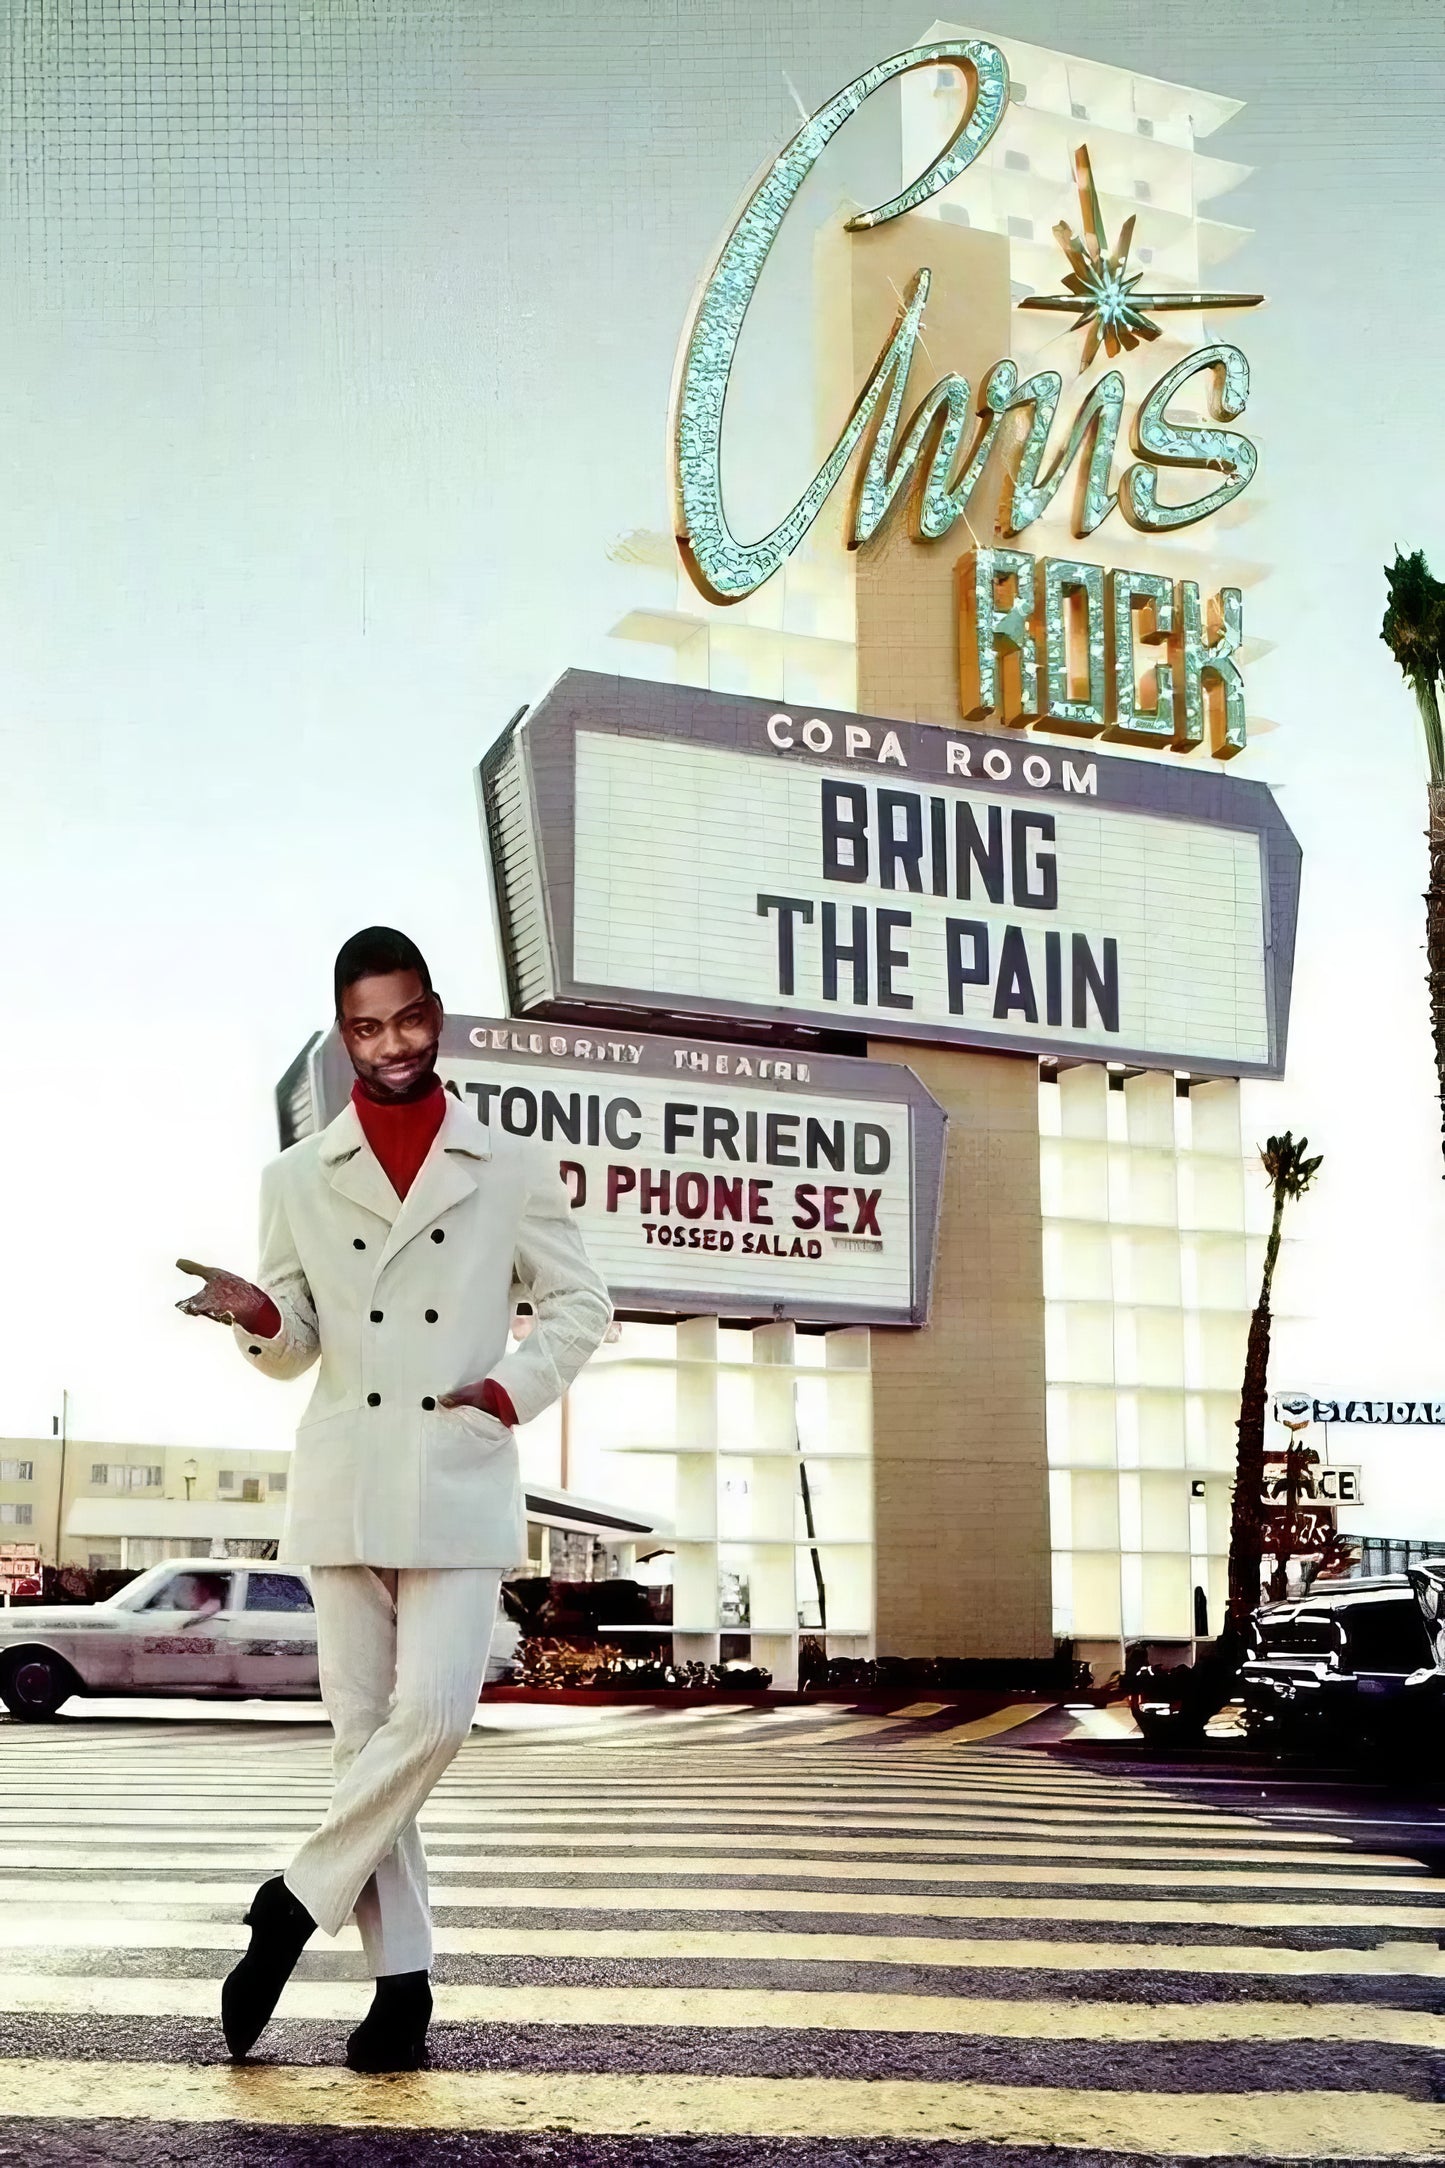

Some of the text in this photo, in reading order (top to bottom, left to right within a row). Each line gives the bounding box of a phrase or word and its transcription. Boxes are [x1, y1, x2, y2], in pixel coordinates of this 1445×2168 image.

[674, 40, 1257, 606] Chris
[955, 548, 1247, 759] ROCK
[766, 713, 1098, 796] COPA ROOM
[821, 778, 1058, 910] BRING
[757, 893, 1120, 1033] THE PAIN
[469, 1027, 645, 1065] CELEBRITY
[444, 1079, 891, 1175] TONIC FRIEND
[606, 1164, 774, 1226] PHONE
[791, 1182, 883, 1237] SEX
[642, 1222, 734, 1252] TOSSED
[742, 1231, 823, 1260] SALAD
